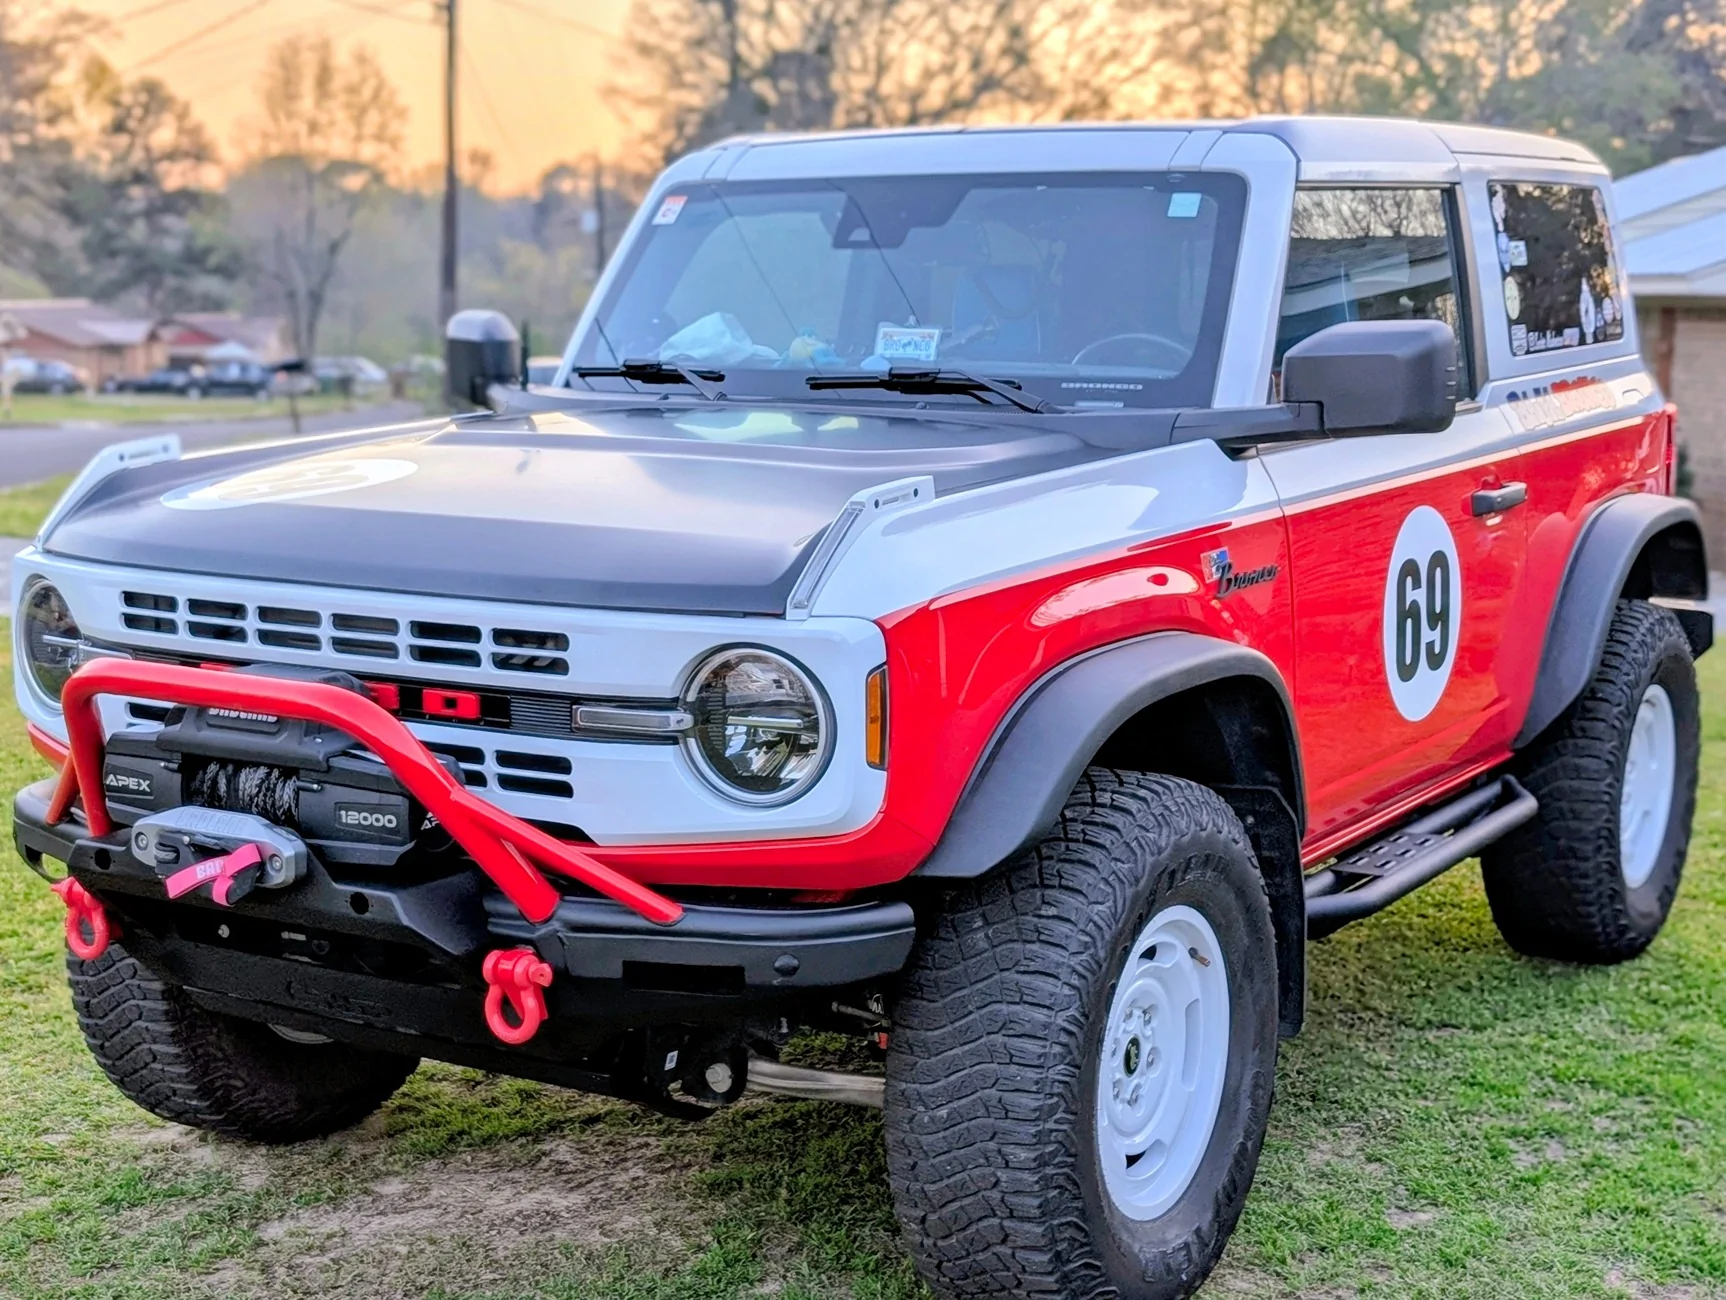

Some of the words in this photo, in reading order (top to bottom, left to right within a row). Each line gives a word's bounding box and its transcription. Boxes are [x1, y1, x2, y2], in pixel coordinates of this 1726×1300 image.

[1396, 550, 1450, 683] 69
[106, 773, 151, 792] APEX
[340, 810, 397, 828] 12000
